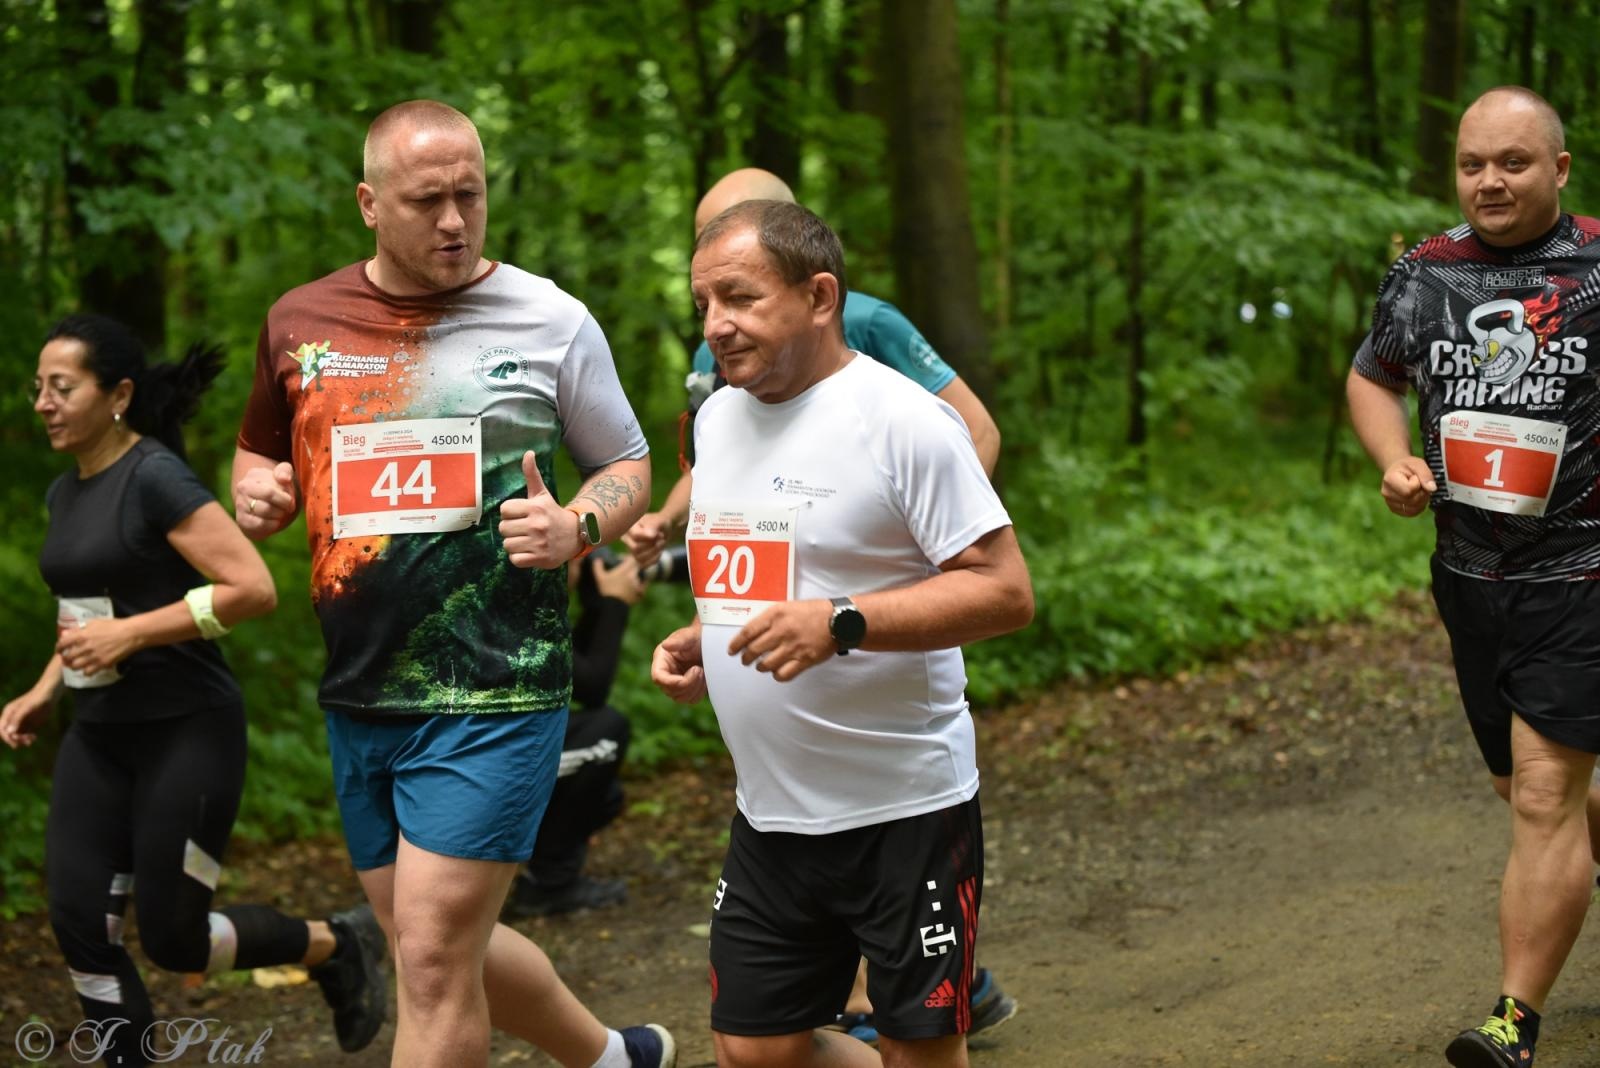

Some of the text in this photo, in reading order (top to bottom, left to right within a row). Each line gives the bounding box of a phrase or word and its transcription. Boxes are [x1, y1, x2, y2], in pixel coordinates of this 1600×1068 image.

[1486, 269, 1542, 280] EXTREME
[343, 433, 366, 447] Bieg
[431, 434, 460, 446] 4500
[462, 435, 473, 445] M
[1449, 416, 1470, 431] Bieg
[1524, 432, 1549, 446] 4500
[1549, 437, 1559, 447] M
[370, 459, 437, 506] 44
[1483, 448, 1504, 489] 1
[756, 521, 778, 532] 4500
[779, 522, 789, 532] M
[704, 544, 755, 595] 20
